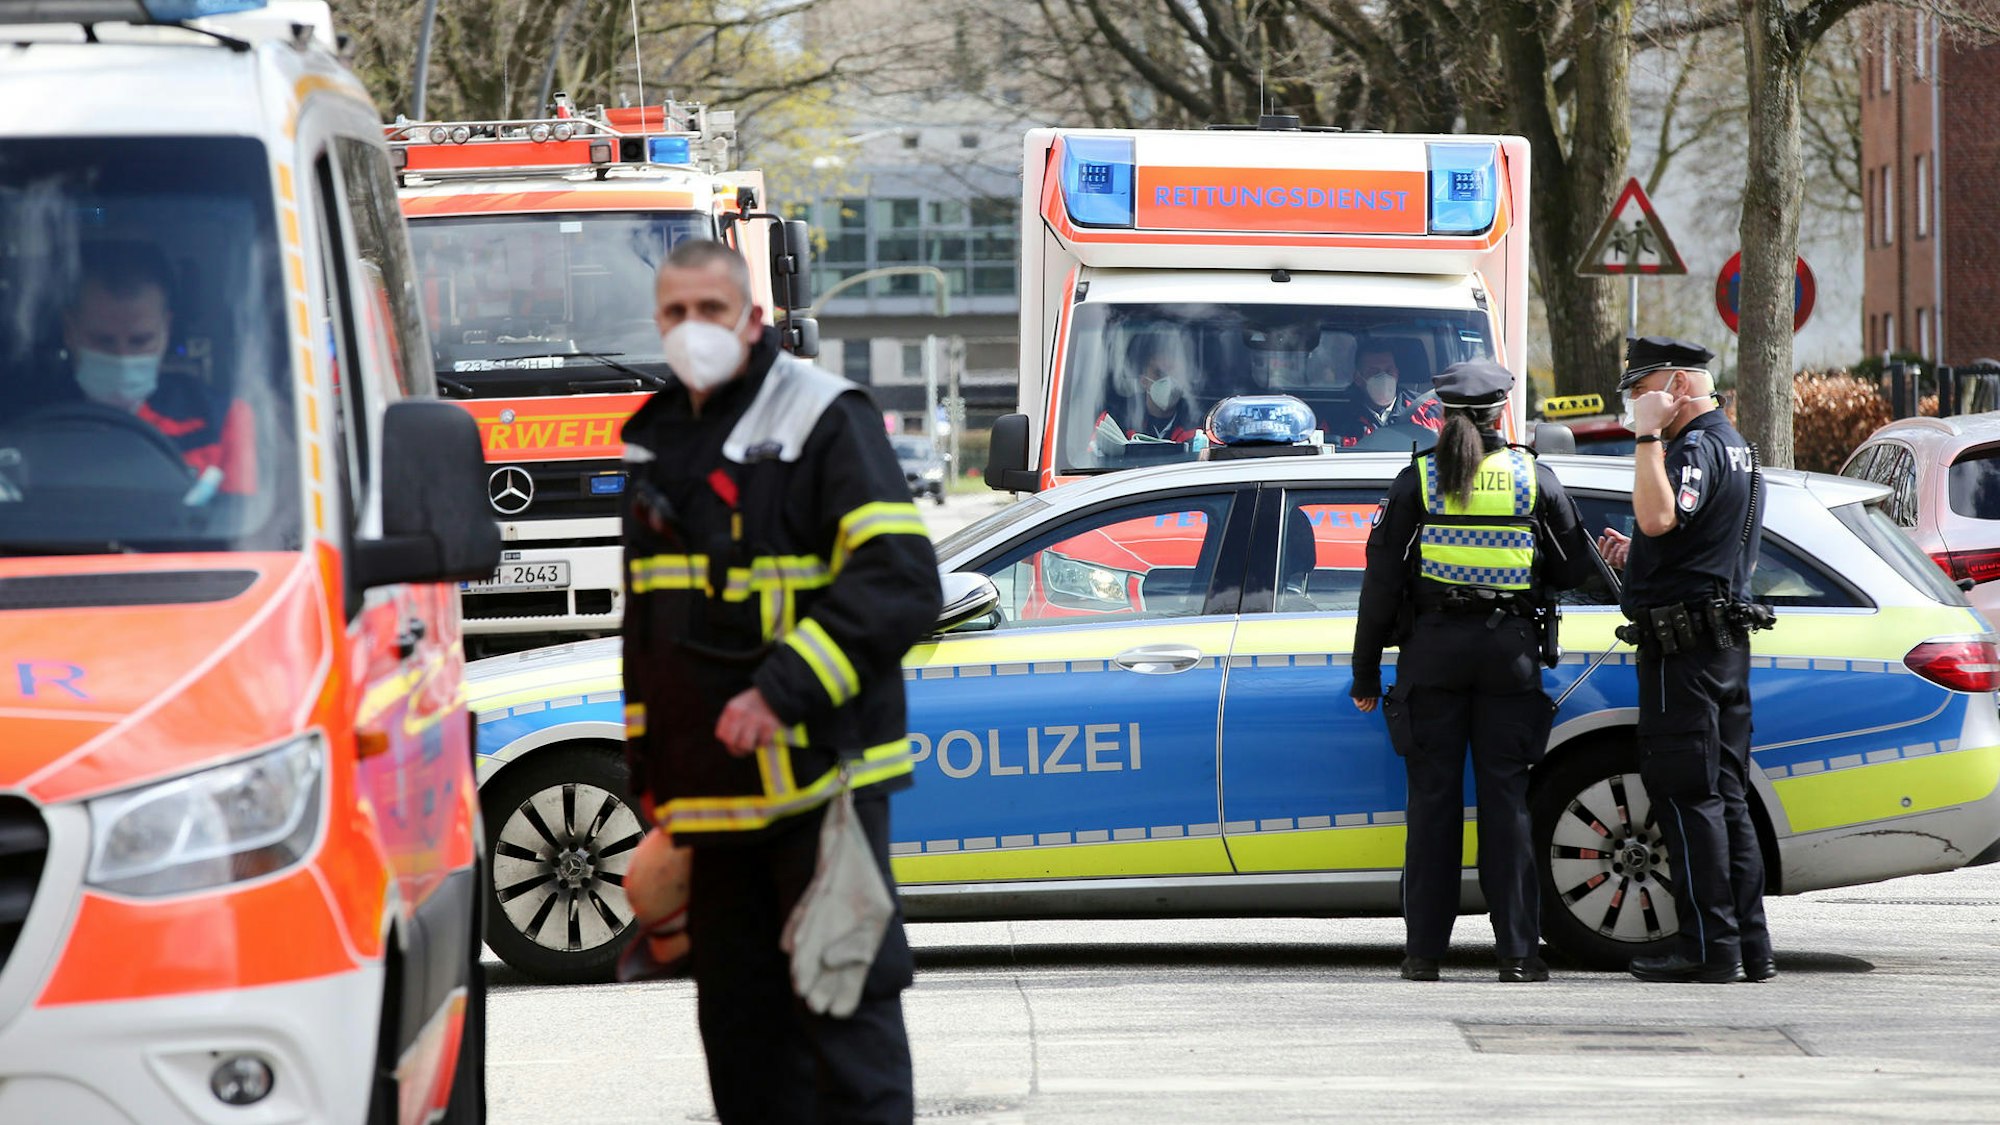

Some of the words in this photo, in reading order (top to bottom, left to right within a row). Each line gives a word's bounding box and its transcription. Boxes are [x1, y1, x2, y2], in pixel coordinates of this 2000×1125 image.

[1155, 186, 1408, 211] RETTUNGSDIENST
[477, 420, 628, 450] RWEH
[513, 565, 559, 584] 2643
[906, 723, 1141, 778] POLIZEI
